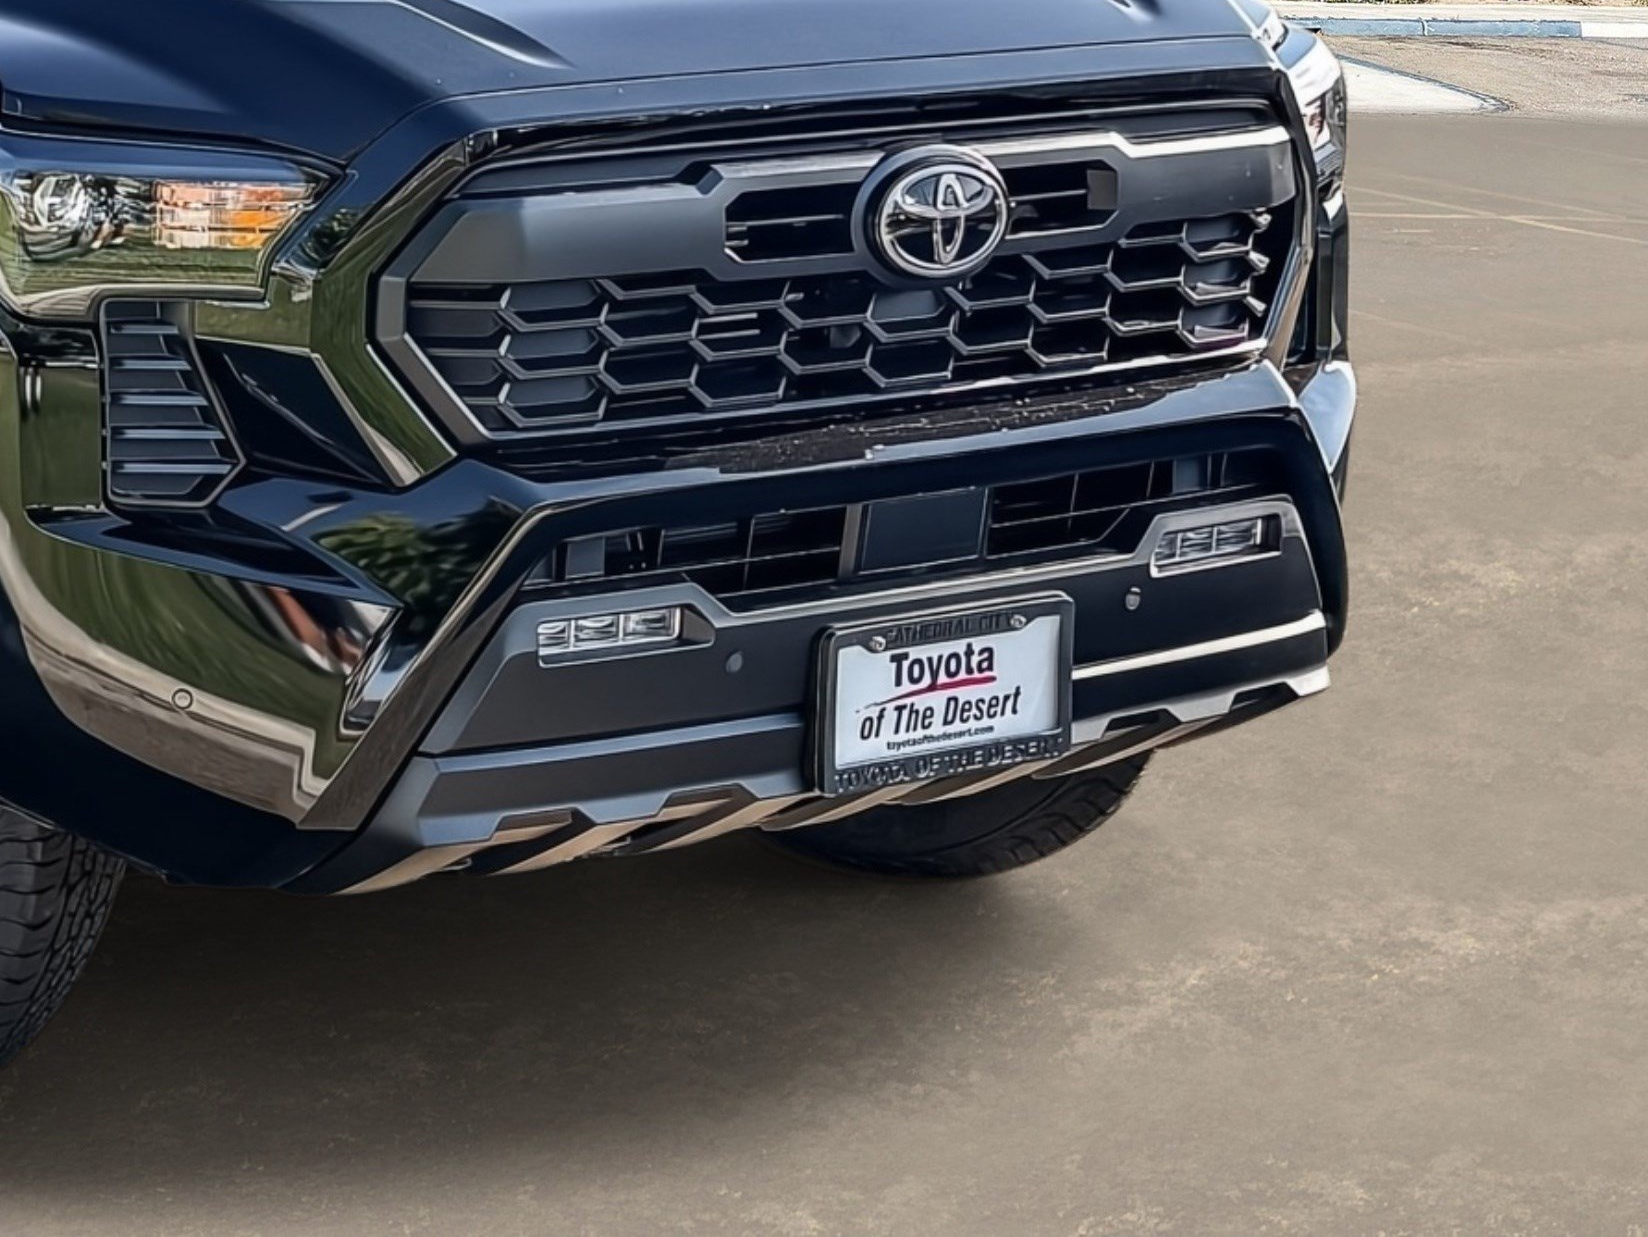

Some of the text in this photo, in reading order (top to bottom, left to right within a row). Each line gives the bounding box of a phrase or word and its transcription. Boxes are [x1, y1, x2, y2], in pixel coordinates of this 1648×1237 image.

[889, 642, 995, 690] Toyota
[859, 685, 1021, 741] of The Desert
[886, 725, 995, 751] toyotaofthedesert.com
[834, 763, 910, 793] TOYOTA
[915, 757, 942, 779] OF
[943, 749, 984, 773] THE
